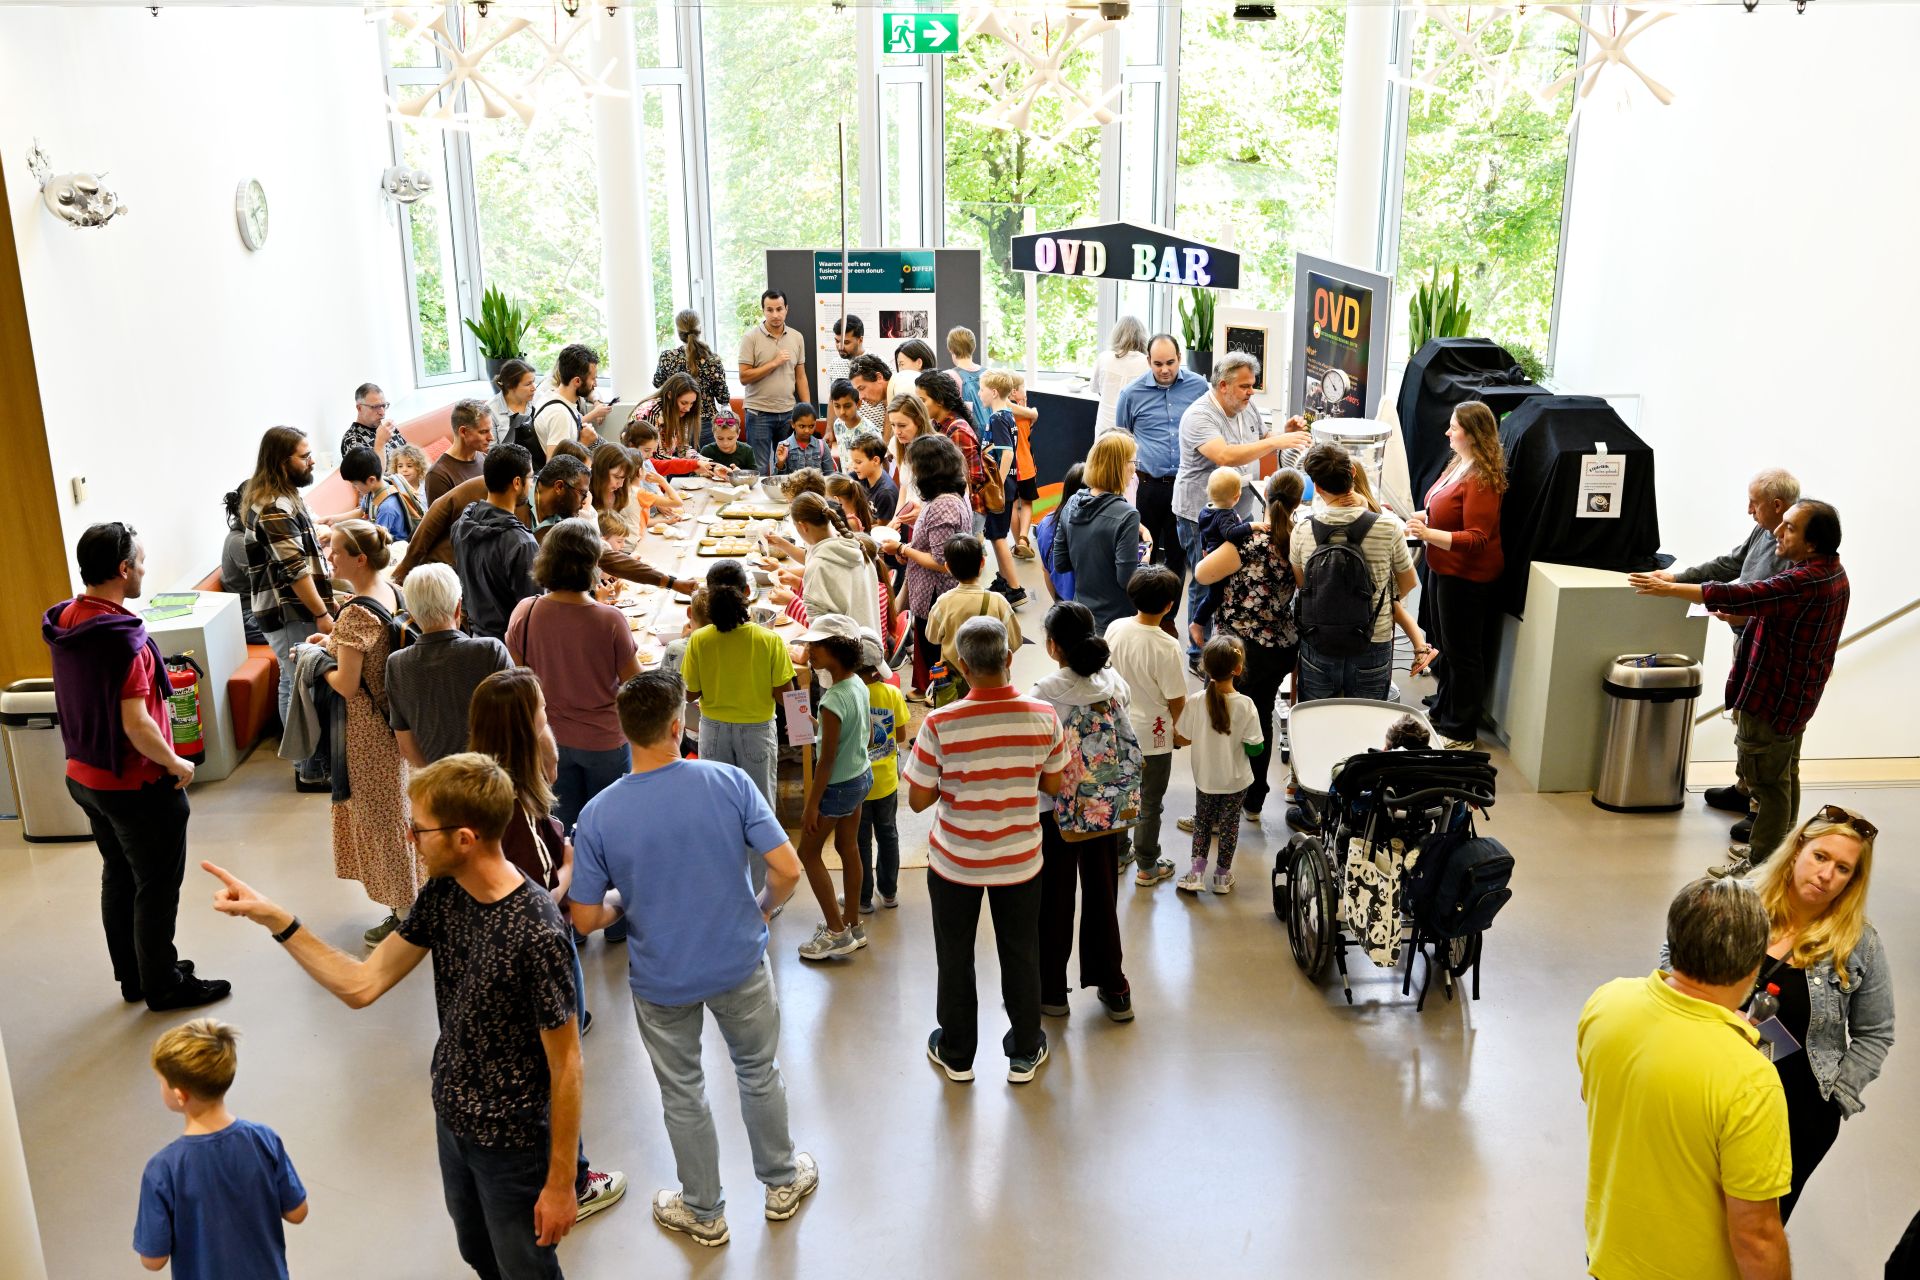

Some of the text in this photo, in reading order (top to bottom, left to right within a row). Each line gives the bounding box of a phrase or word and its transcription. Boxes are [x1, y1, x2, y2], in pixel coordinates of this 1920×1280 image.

[1034, 237, 1211, 287] OVD BAR
[1314, 287, 1360, 339] OVD
[1229, 340, 1264, 355] DONUT
